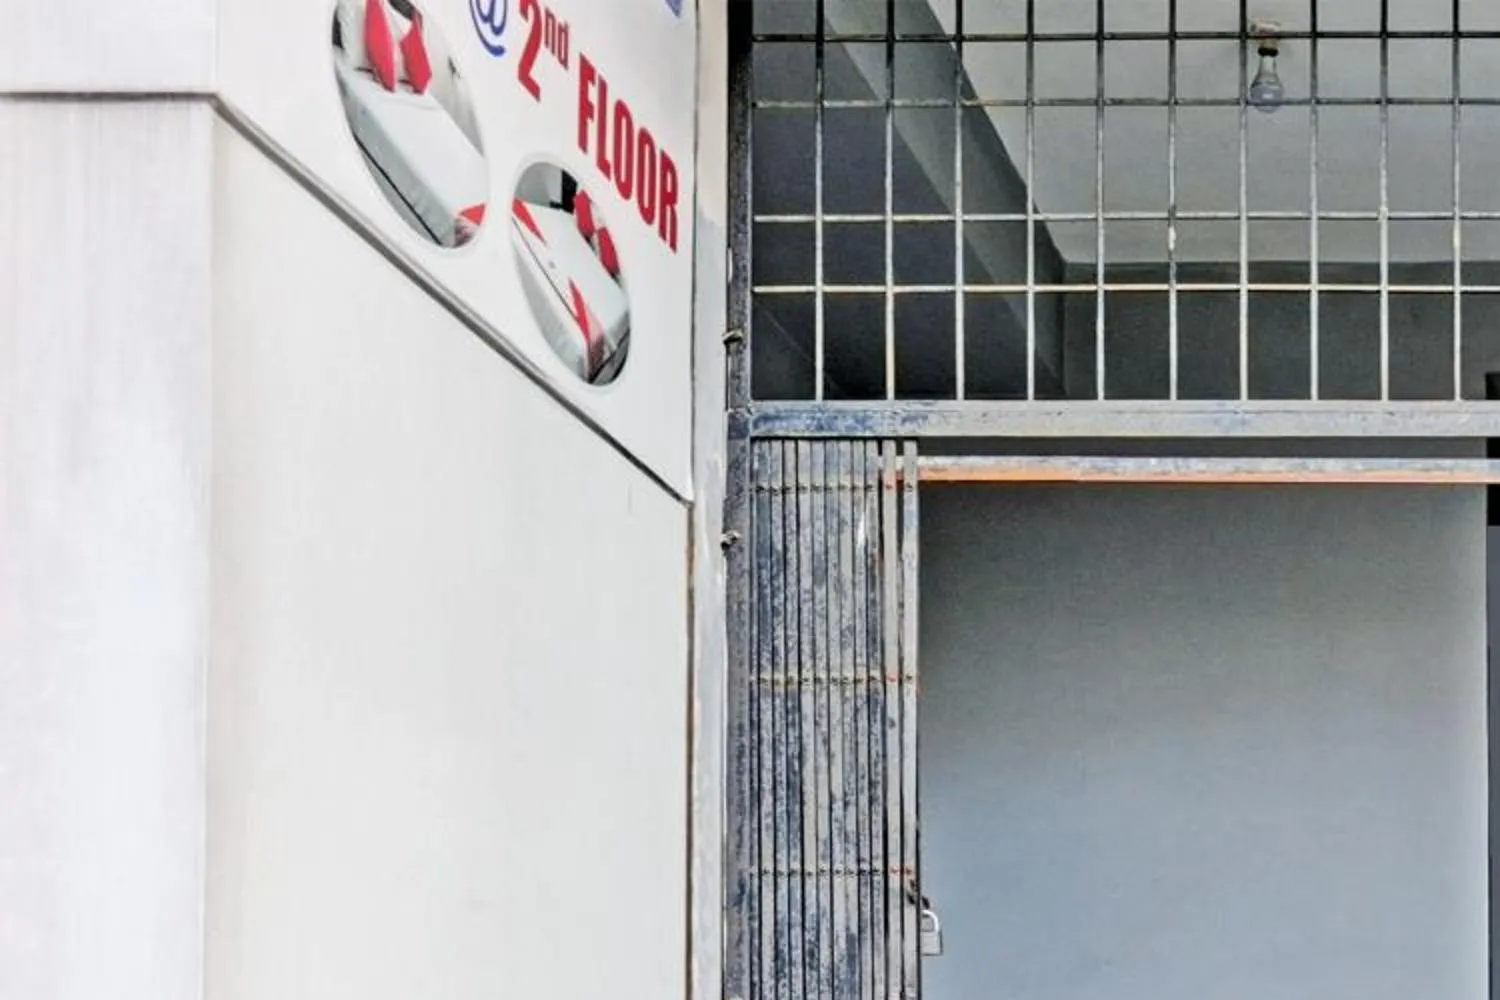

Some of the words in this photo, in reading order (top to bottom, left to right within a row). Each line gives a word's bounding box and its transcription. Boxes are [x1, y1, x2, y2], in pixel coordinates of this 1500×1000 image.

[469, 0, 507, 57] @
[518, 0, 569, 102] 2nd
[577, 52, 679, 254] FLOOR
